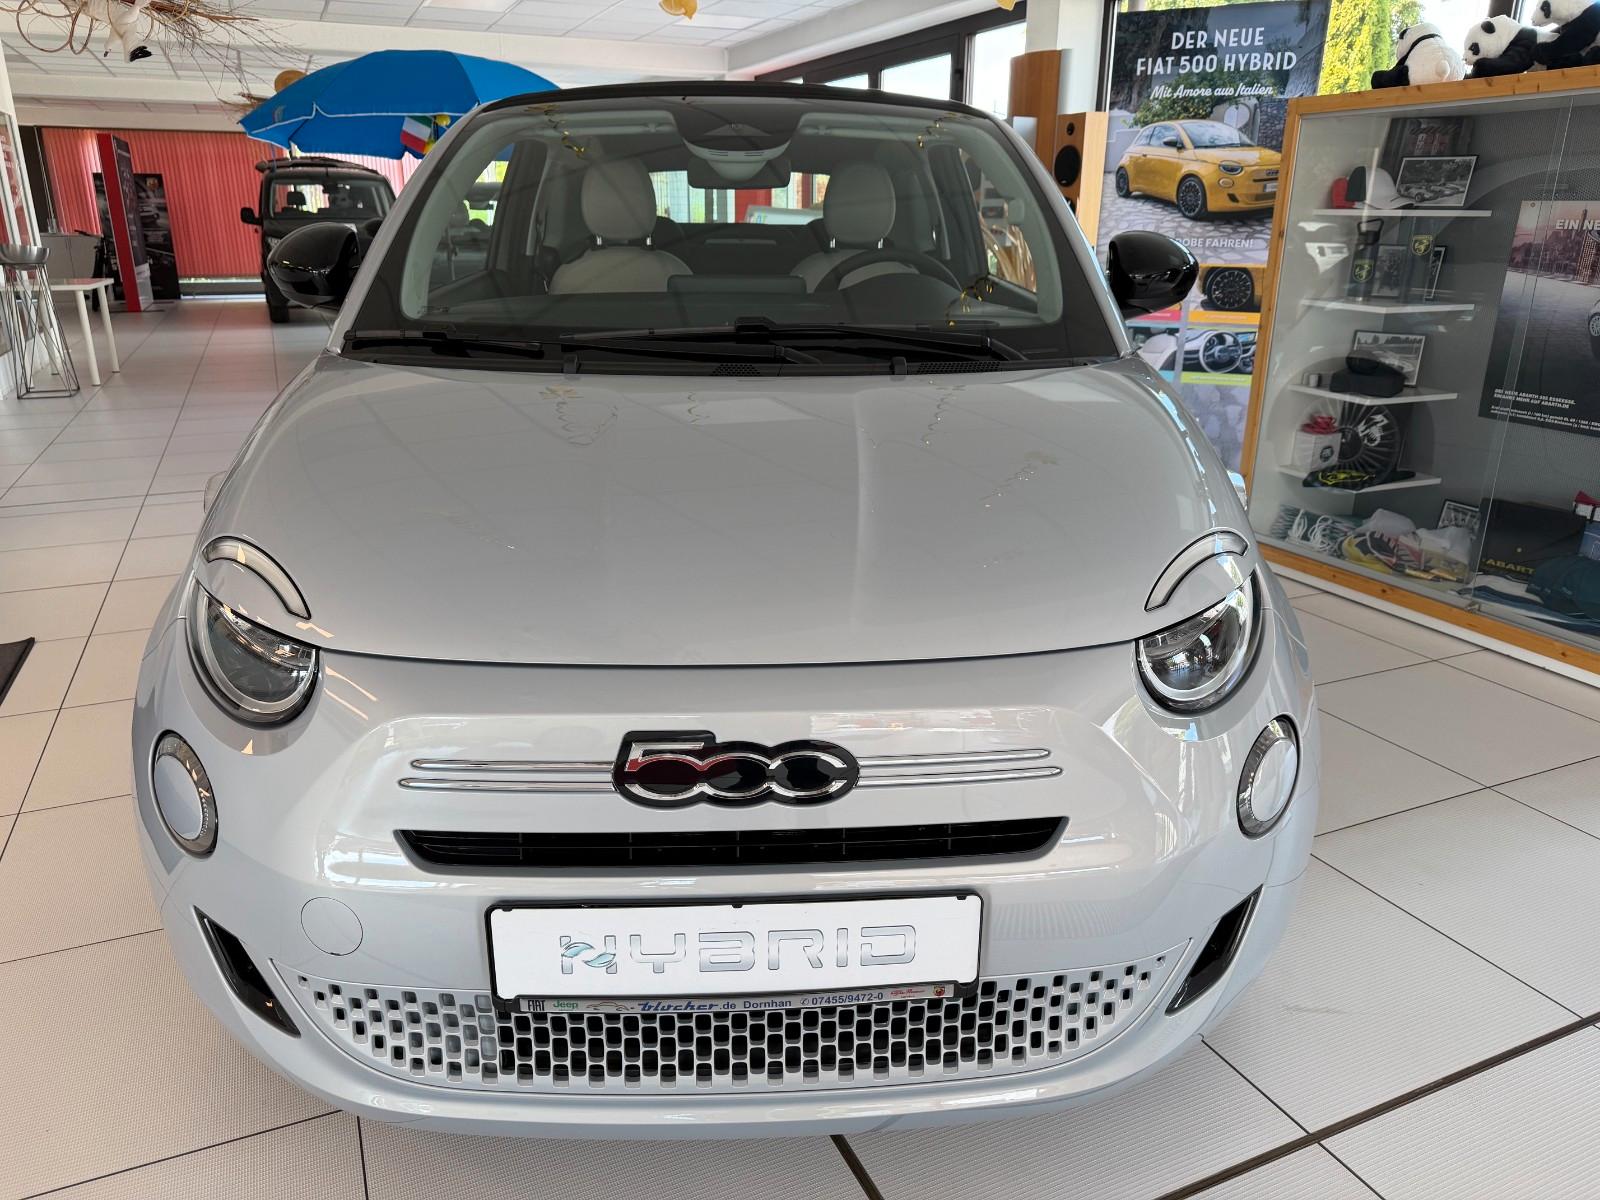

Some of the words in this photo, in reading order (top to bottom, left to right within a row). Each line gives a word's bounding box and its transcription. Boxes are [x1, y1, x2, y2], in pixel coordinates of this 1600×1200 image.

[1171, 31, 1208, 50] DER
[1214, 27, 1265, 48] NEUE
[1136, 56, 1175, 76] FIAT
[1179, 54, 1218, 74] 500
[1223, 51, 1297, 72] HYBRID
[1150, 86, 1172, 100] Mit
[1173, 85, 1212, 98] Amore
[1213, 87, 1234, 97] aus
[1234, 82, 1274, 97] Italien
[1555, 219, 1580, 230] EIN
[1205, 238, 1254, 248] FAHREN!
[1485, 558, 1536, 574] ABART
[623, 740, 849, 800] 500
[558, 924, 918, 975] HYBRID
[527, 999, 546, 1012] FIAT
[552, 999, 579, 1010] Jeep
[743, 999, 792, 1010] Dornhan
[811, 991, 883, 1006] 07455/9472-0
